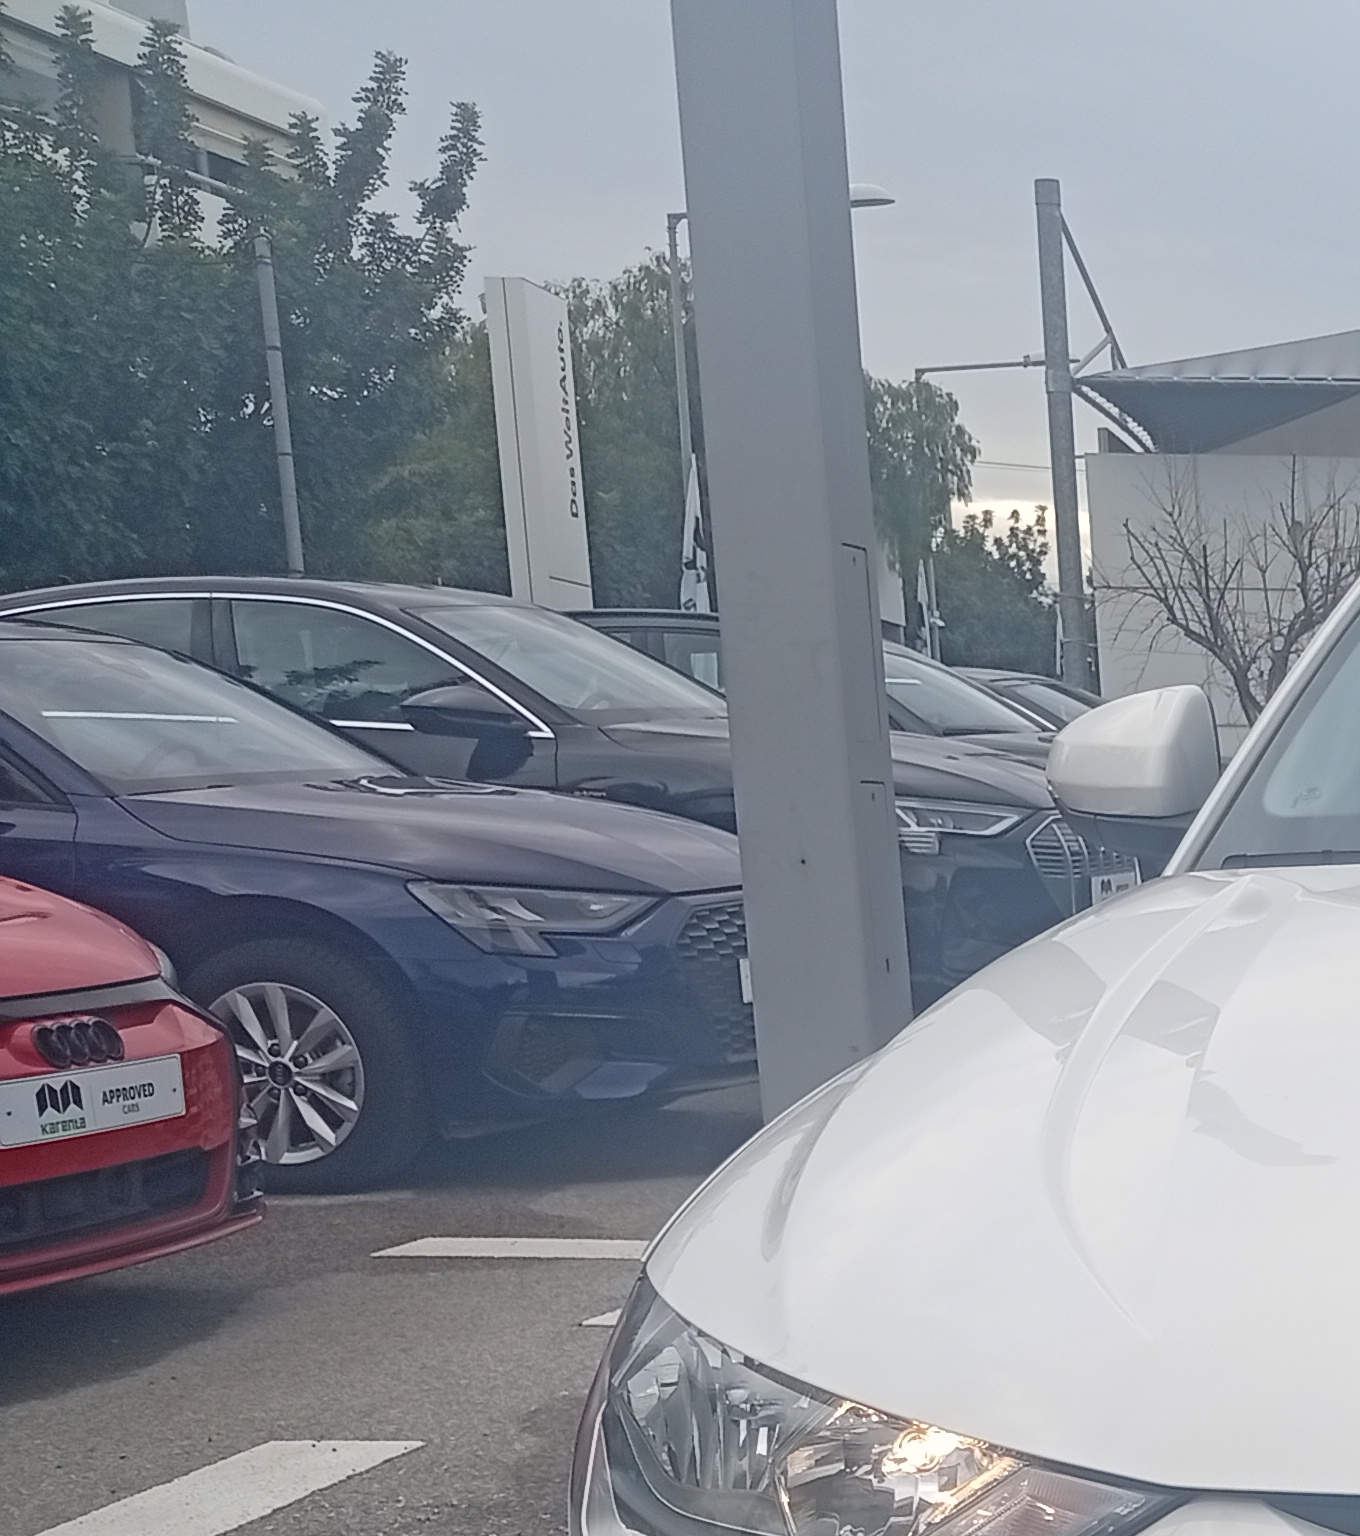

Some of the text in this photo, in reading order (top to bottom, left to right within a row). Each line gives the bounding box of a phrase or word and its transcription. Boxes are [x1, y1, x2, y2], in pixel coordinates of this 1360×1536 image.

[569, 466, 579, 518] Das
[101, 1082, 155, 1106] APPROVED
[122, 1102, 140, 1115] CARS
